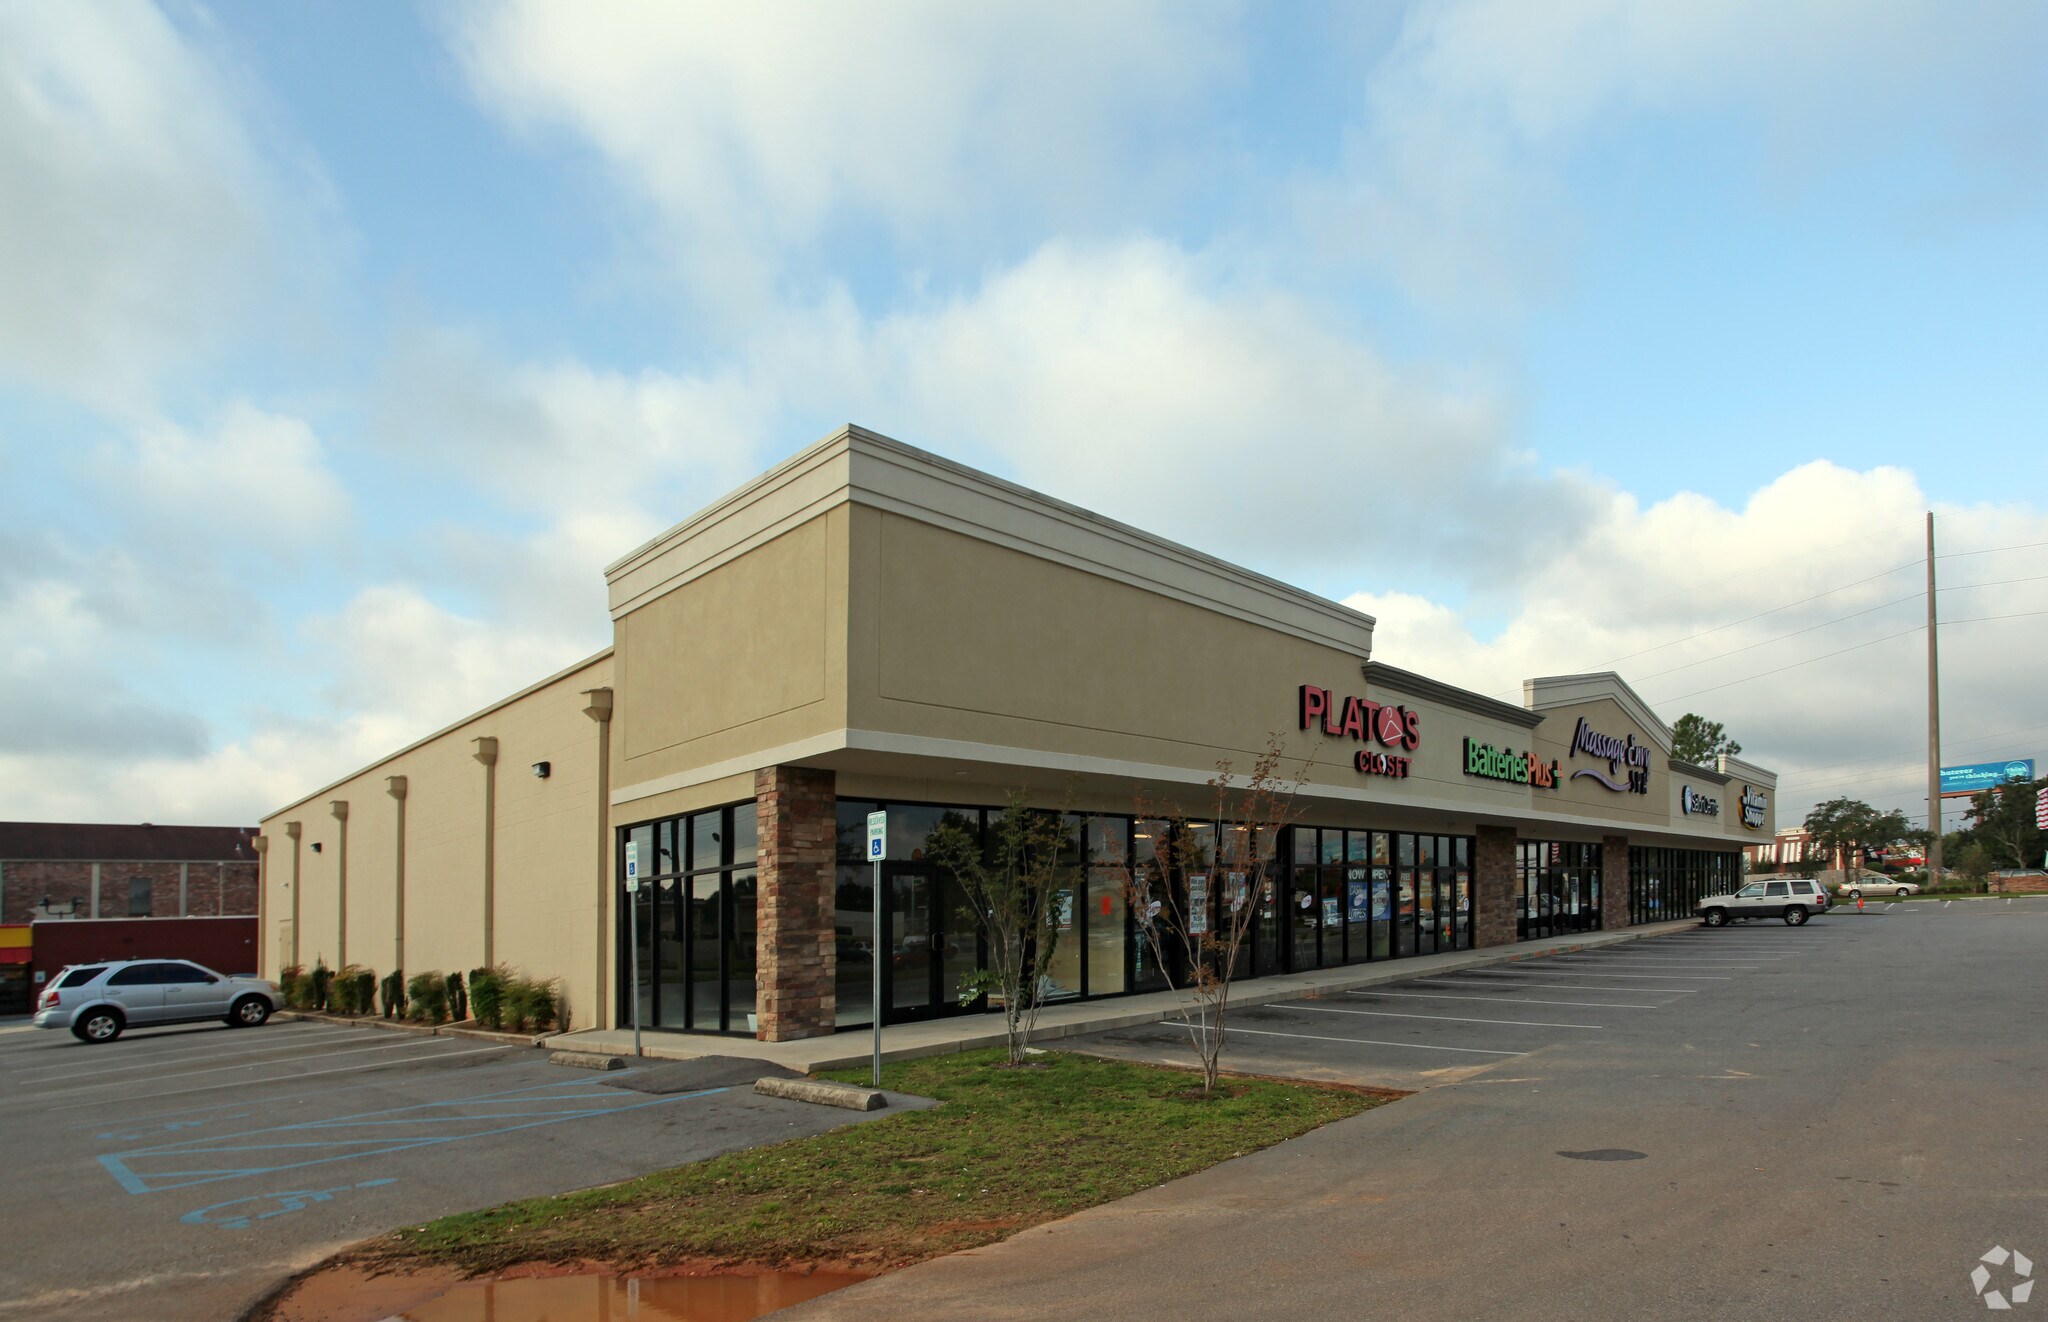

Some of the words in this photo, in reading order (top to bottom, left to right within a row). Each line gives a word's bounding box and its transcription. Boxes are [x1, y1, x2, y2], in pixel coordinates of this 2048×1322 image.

[1299, 685, 1420, 751] PLATO'S
[1570, 716, 1626, 775] Massage
[1625, 734, 1652, 778] Envy
[1354, 750, 1414, 778] CLOSET
